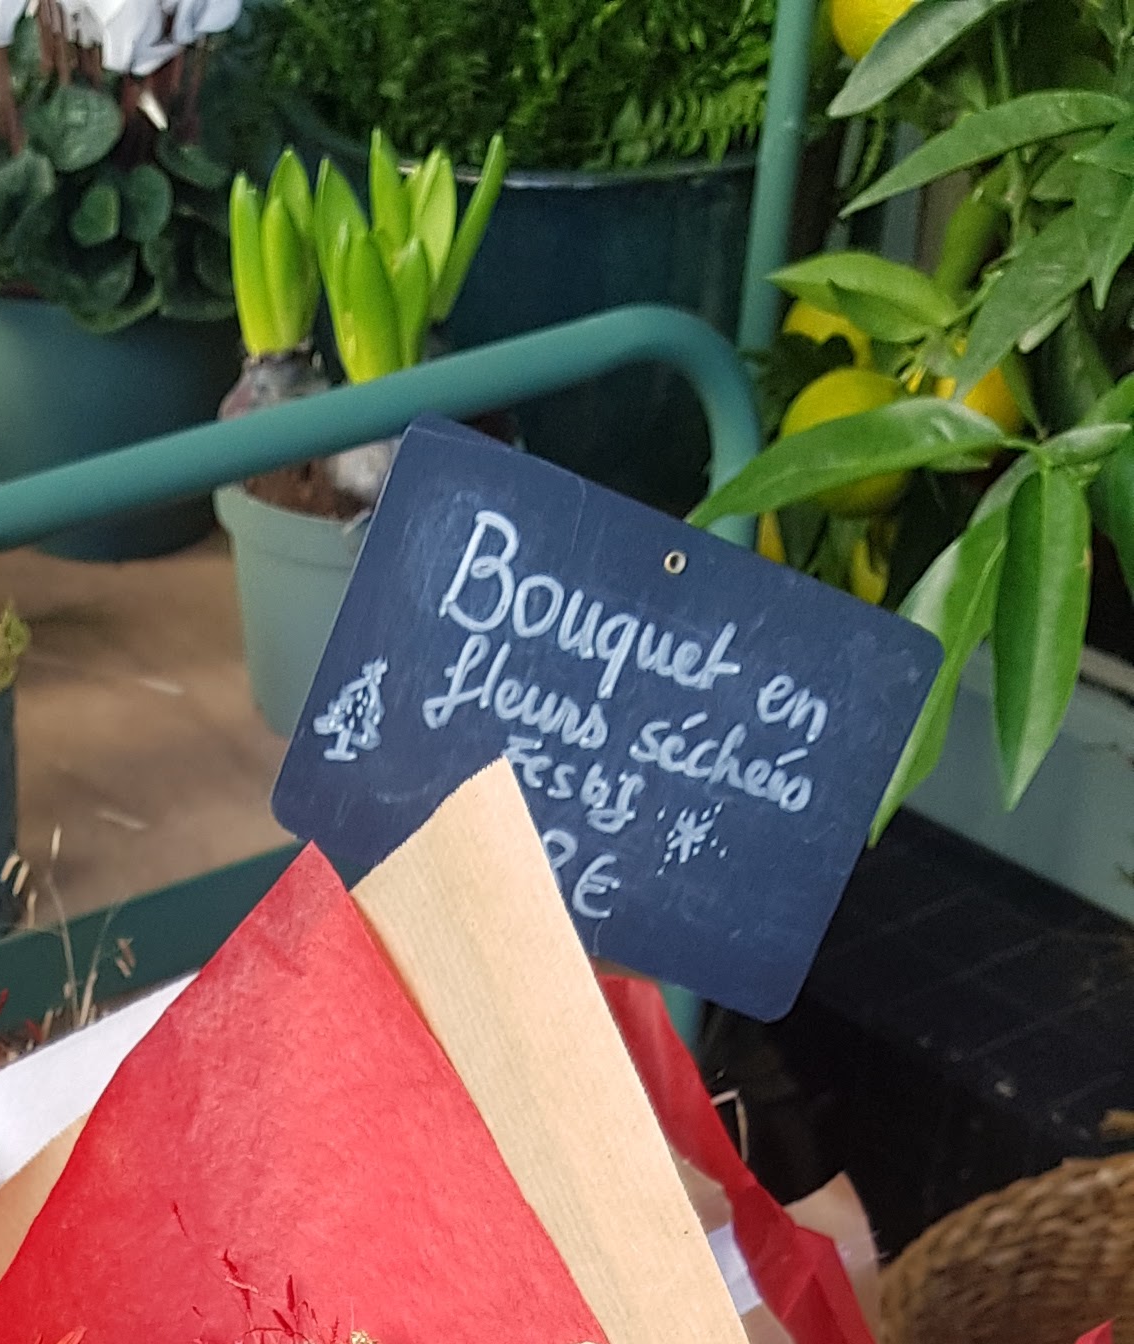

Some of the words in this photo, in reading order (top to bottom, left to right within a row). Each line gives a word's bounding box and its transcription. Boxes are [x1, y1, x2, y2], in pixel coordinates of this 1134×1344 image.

[422, 634, 609, 750] fleurs
[439, 510, 742, 699] Bouquet
[756, 674, 829, 743] en
